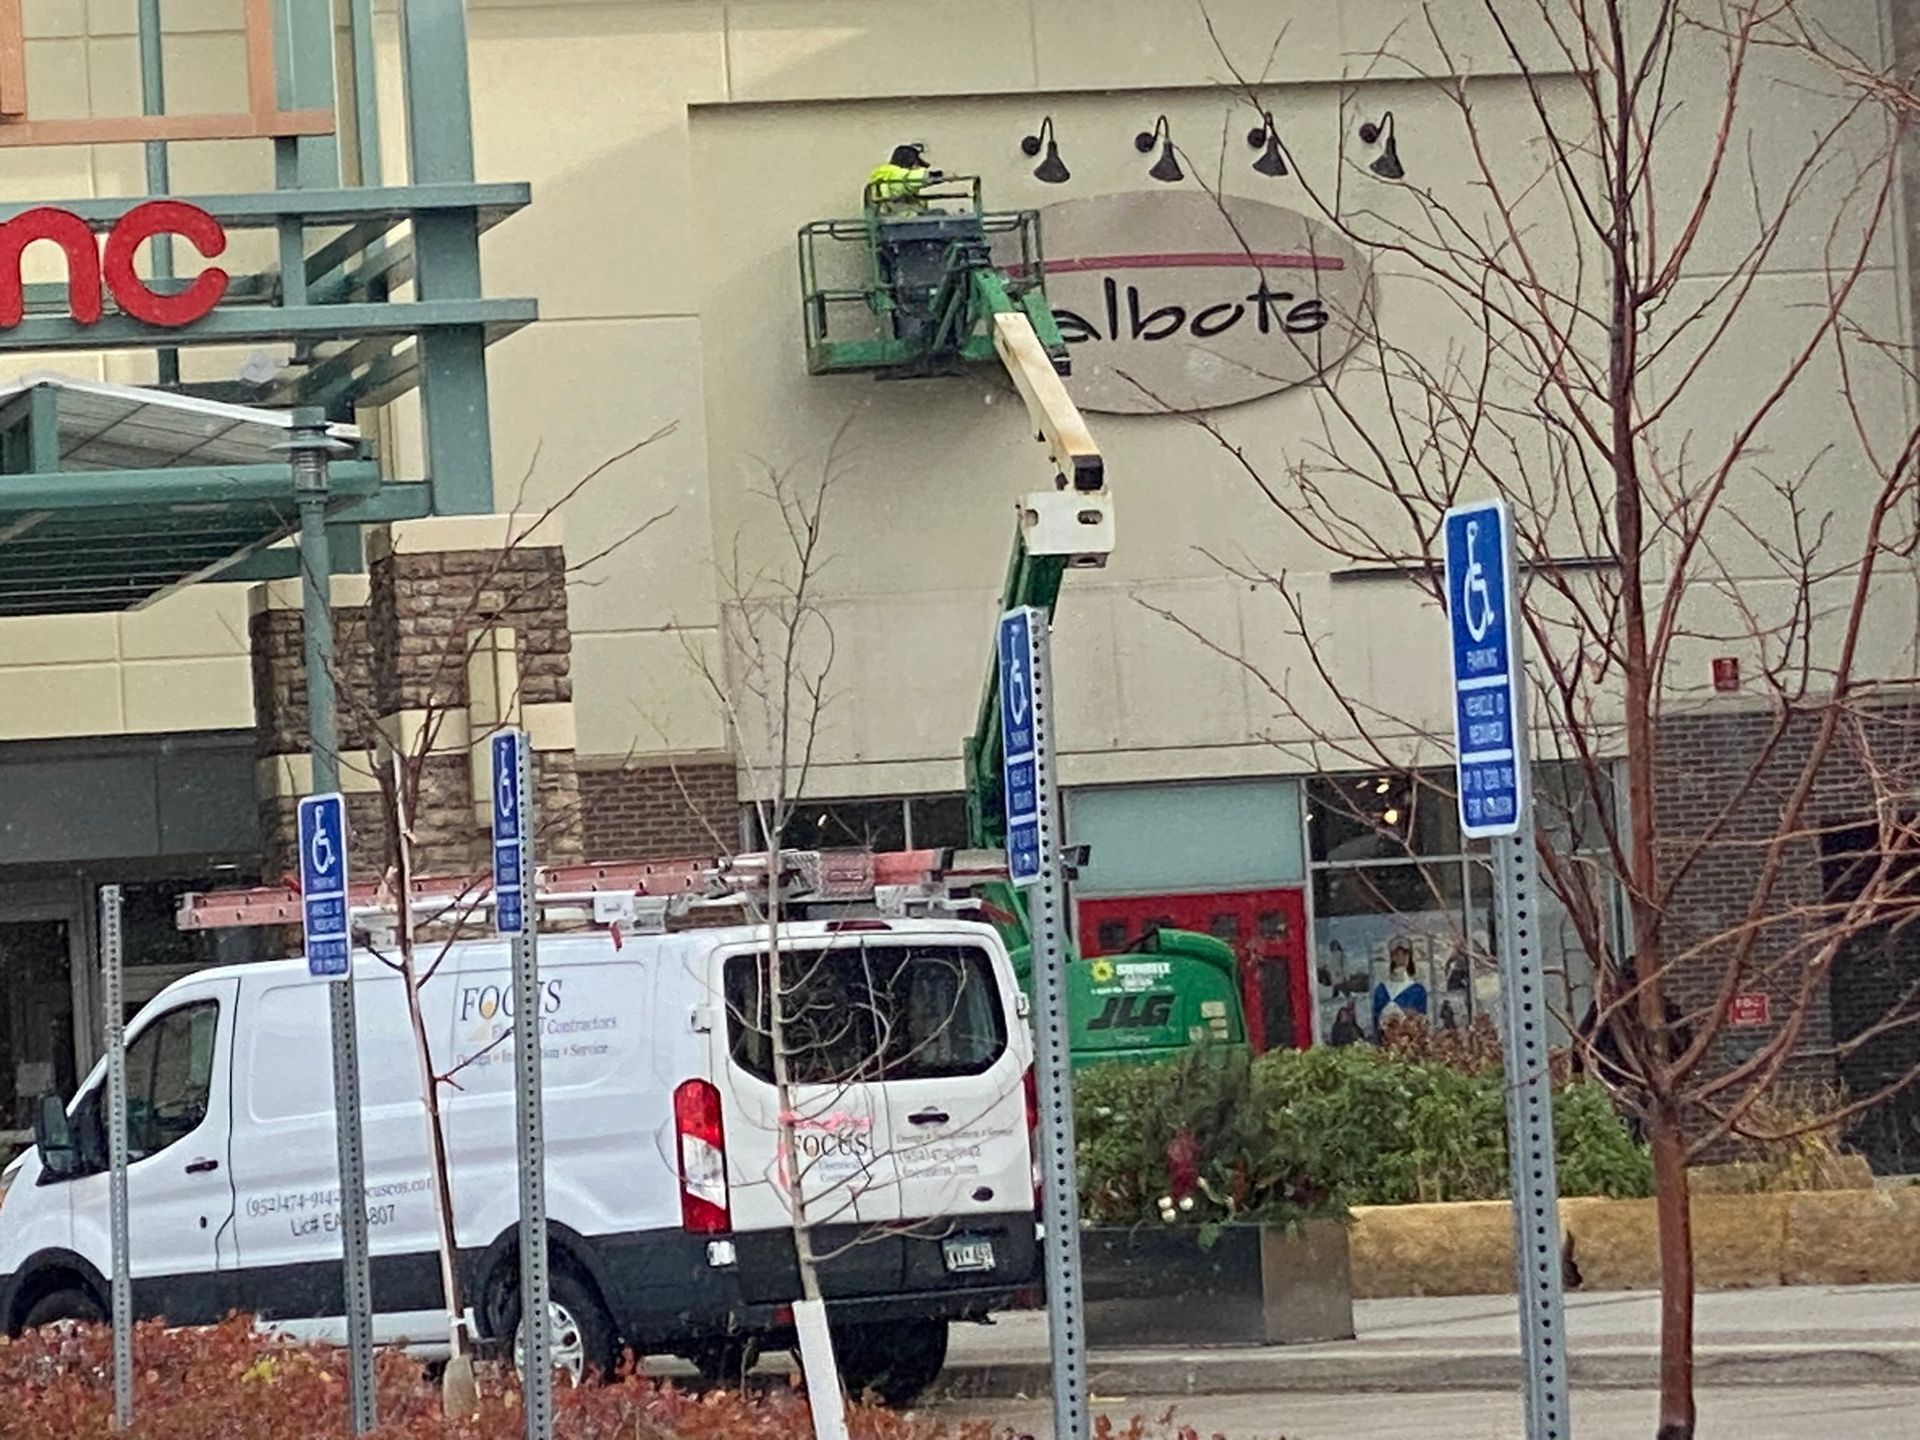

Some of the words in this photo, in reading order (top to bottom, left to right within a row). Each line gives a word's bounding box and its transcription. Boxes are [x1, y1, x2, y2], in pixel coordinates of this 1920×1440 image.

[1051, 276, 1329, 342] albots
[1466, 648, 1498, 672] PARKING
[1086, 993, 1176, 1030] JLG
[548, 1016, 617, 1034] Contractors
[570, 1043, 608, 1057] Service
[246, 1190, 341, 1218] (952)474-914
